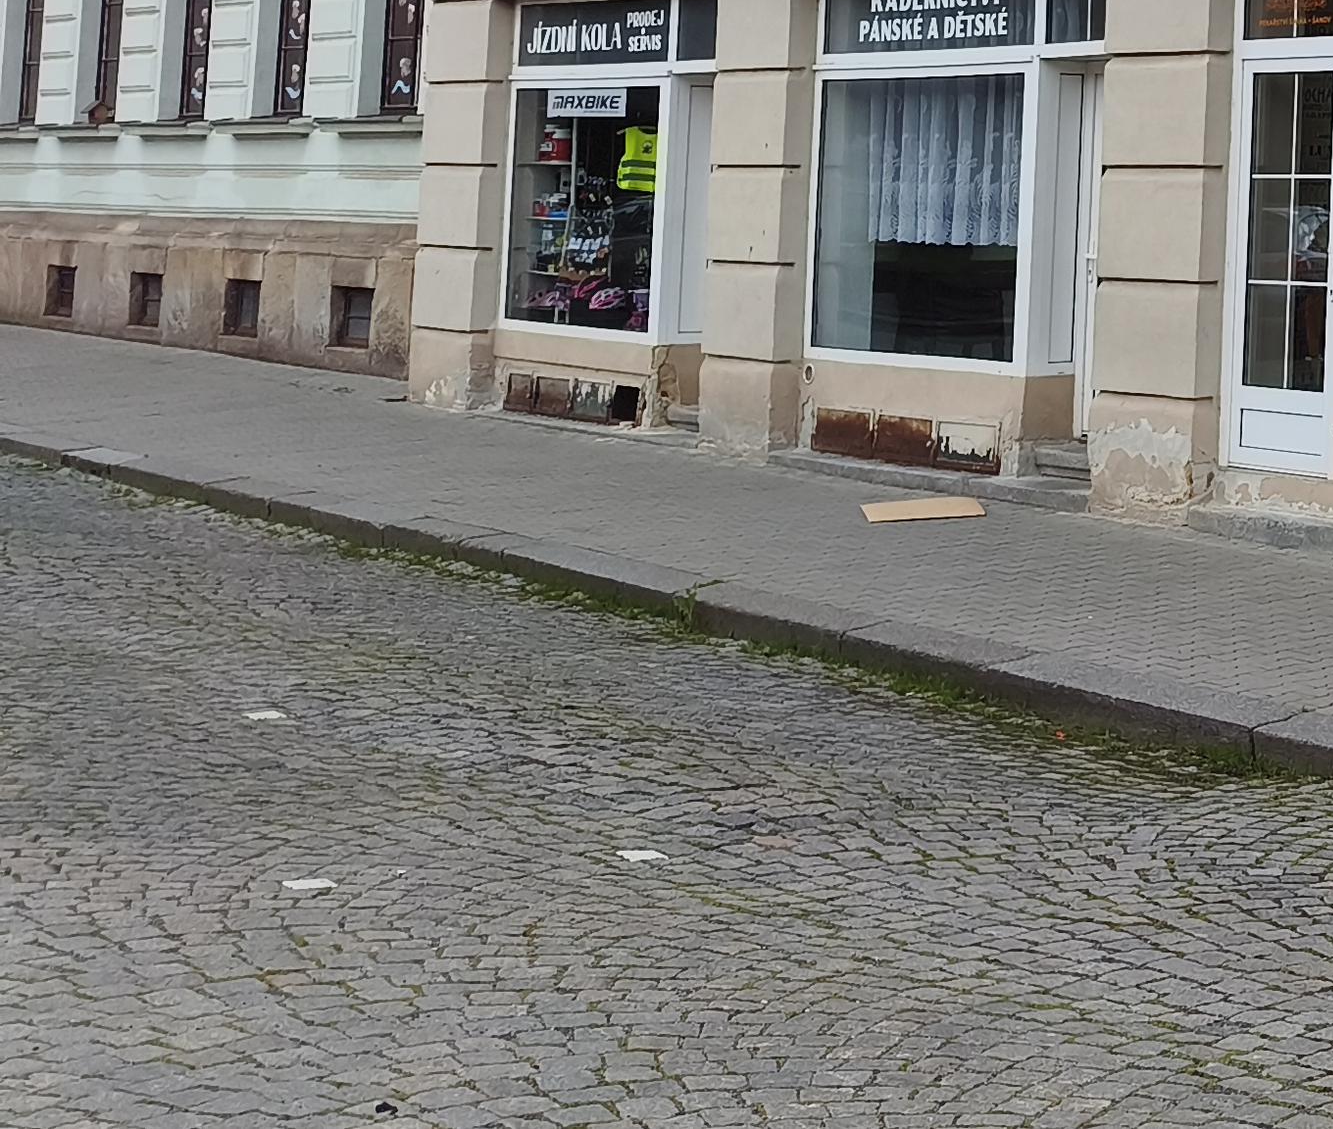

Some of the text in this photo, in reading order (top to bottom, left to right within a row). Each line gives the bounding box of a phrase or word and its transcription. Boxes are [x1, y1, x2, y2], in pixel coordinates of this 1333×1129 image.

[627, 9, 665, 28] PRODEJ
[859, 6, 1008, 43] PÁNSKÉ A DĚTSKÉ
[527, 19, 622, 53] JÍZDNÍ KOLA
[628, 34, 662, 52] SERVIS
[552, 95, 622, 111] MAXBIKE
